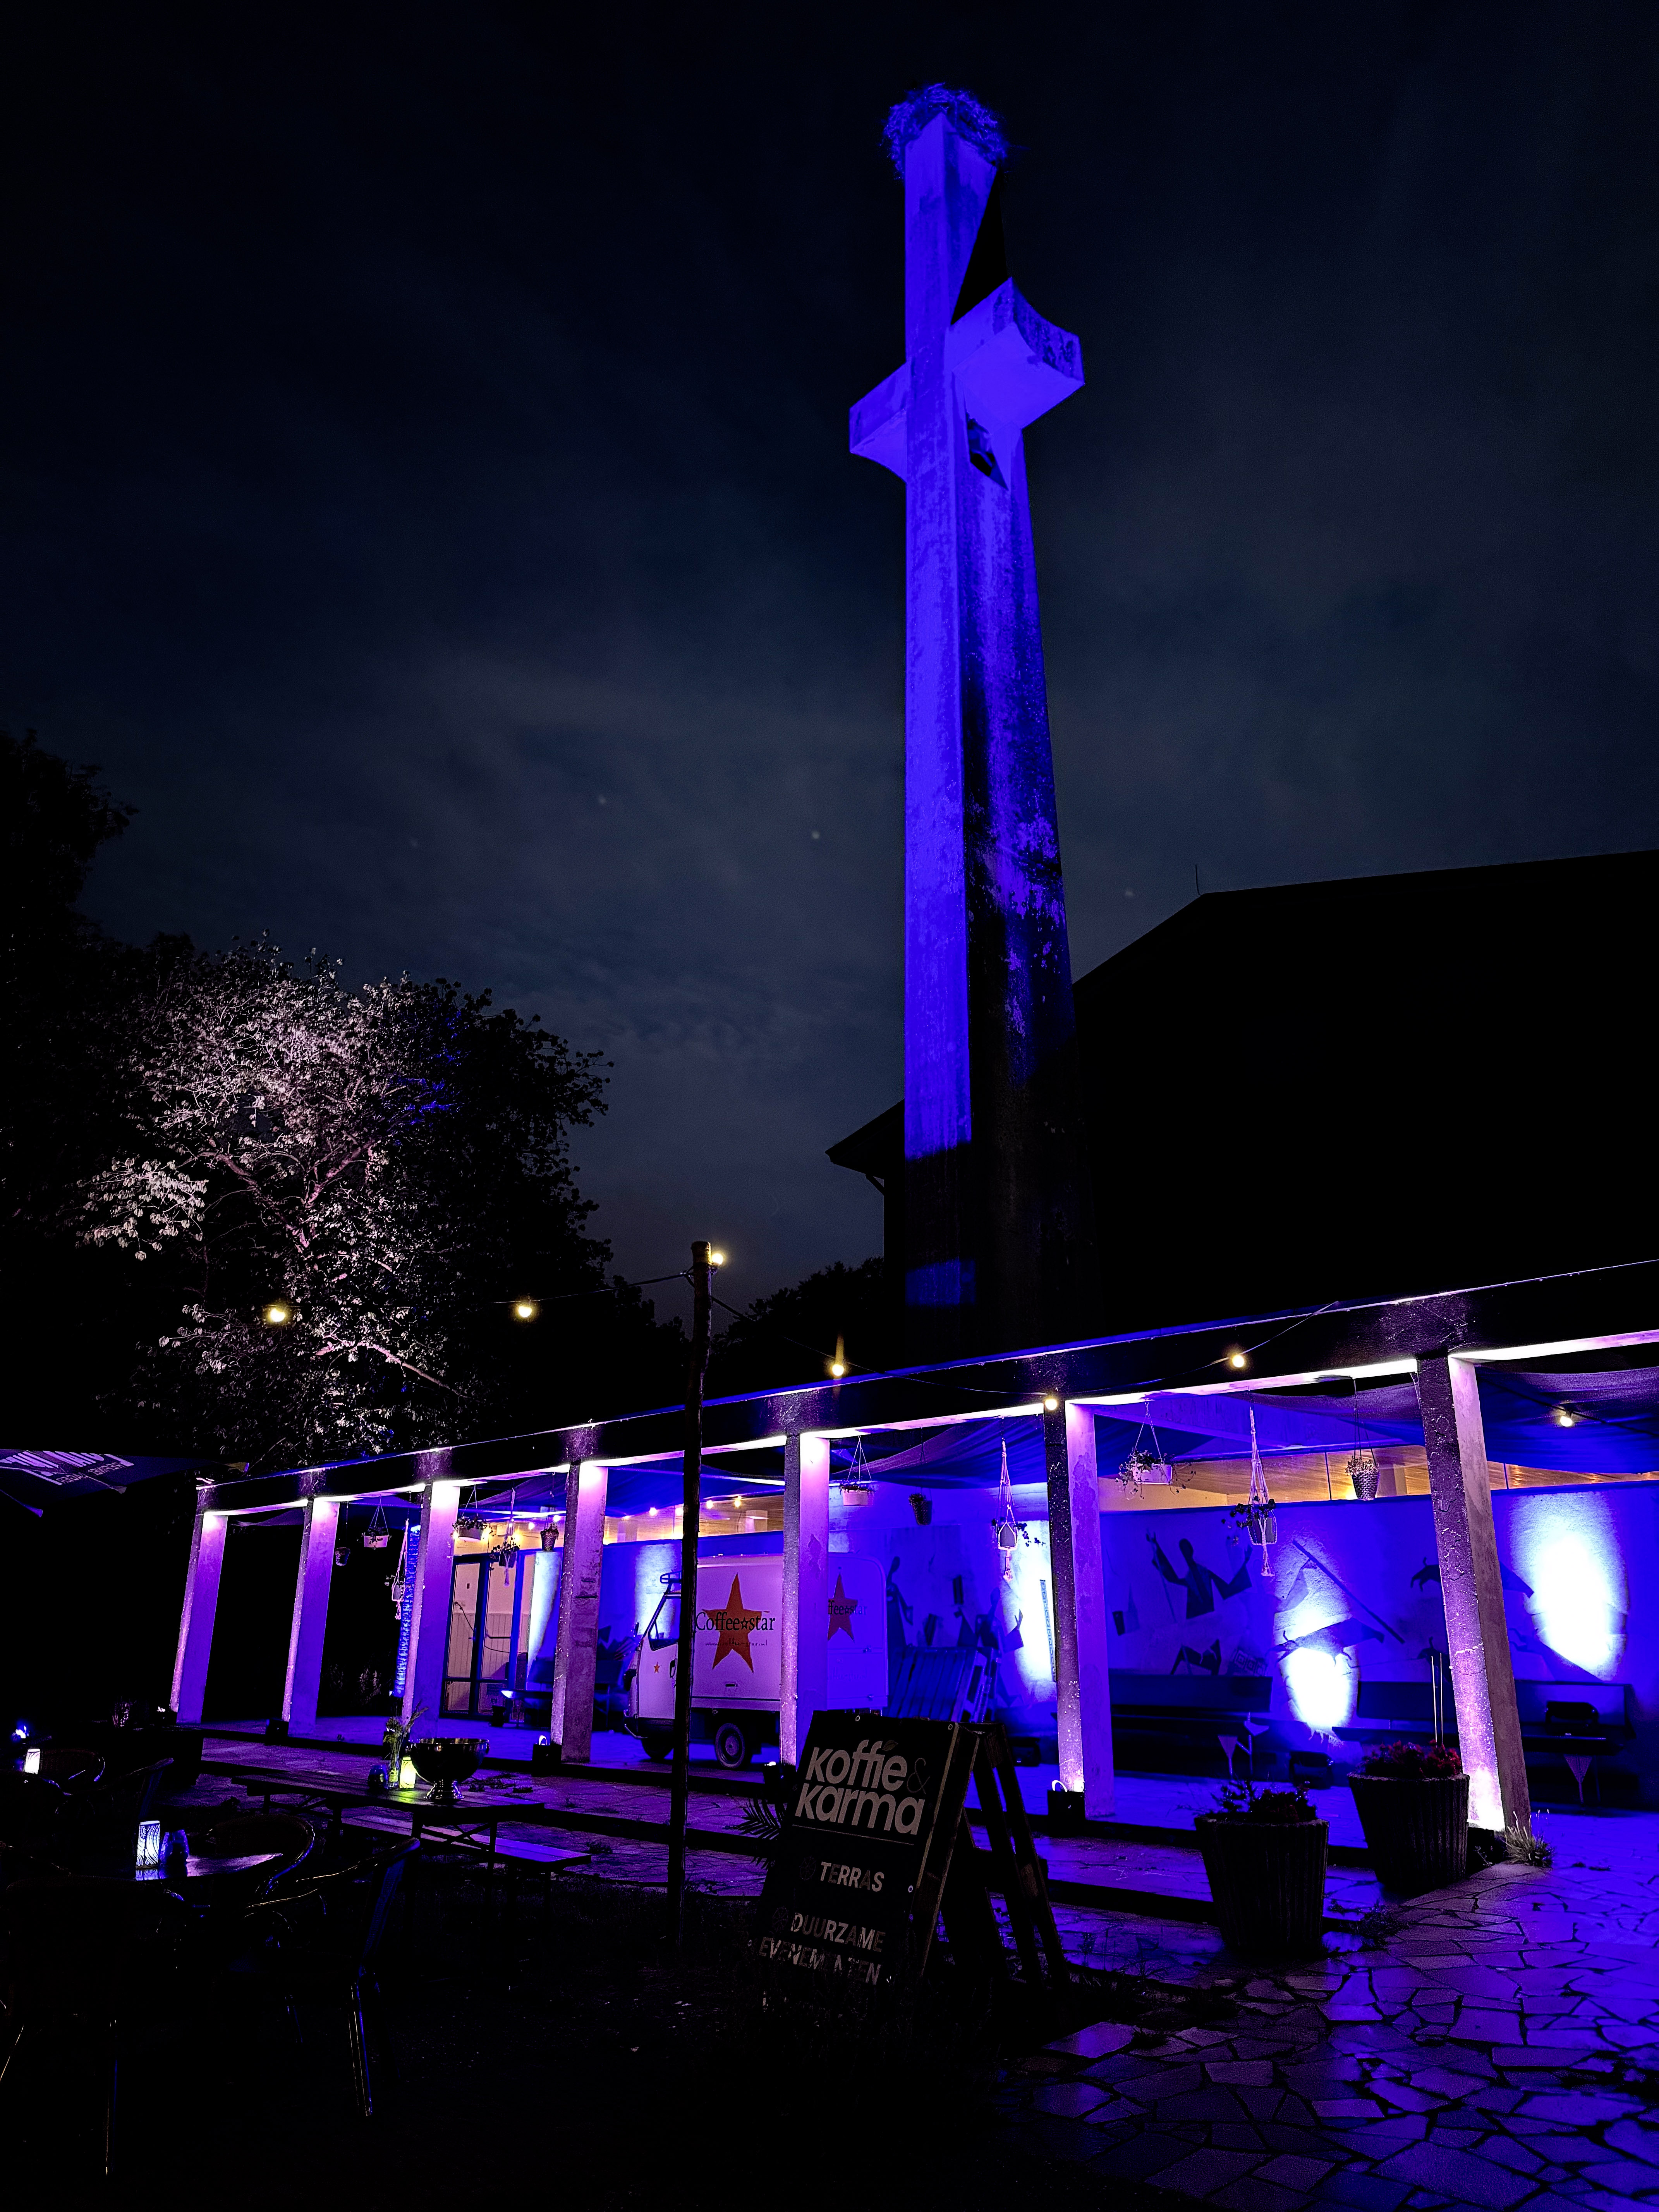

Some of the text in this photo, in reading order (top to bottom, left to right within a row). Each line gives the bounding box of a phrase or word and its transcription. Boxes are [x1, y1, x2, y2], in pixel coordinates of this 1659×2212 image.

[805, 1739, 907, 1791] koffie
[795, 1783, 925, 1835] karma
[820, 1861, 884, 1892] TERRAS
[790, 1912, 886, 1952] DUURZAME
